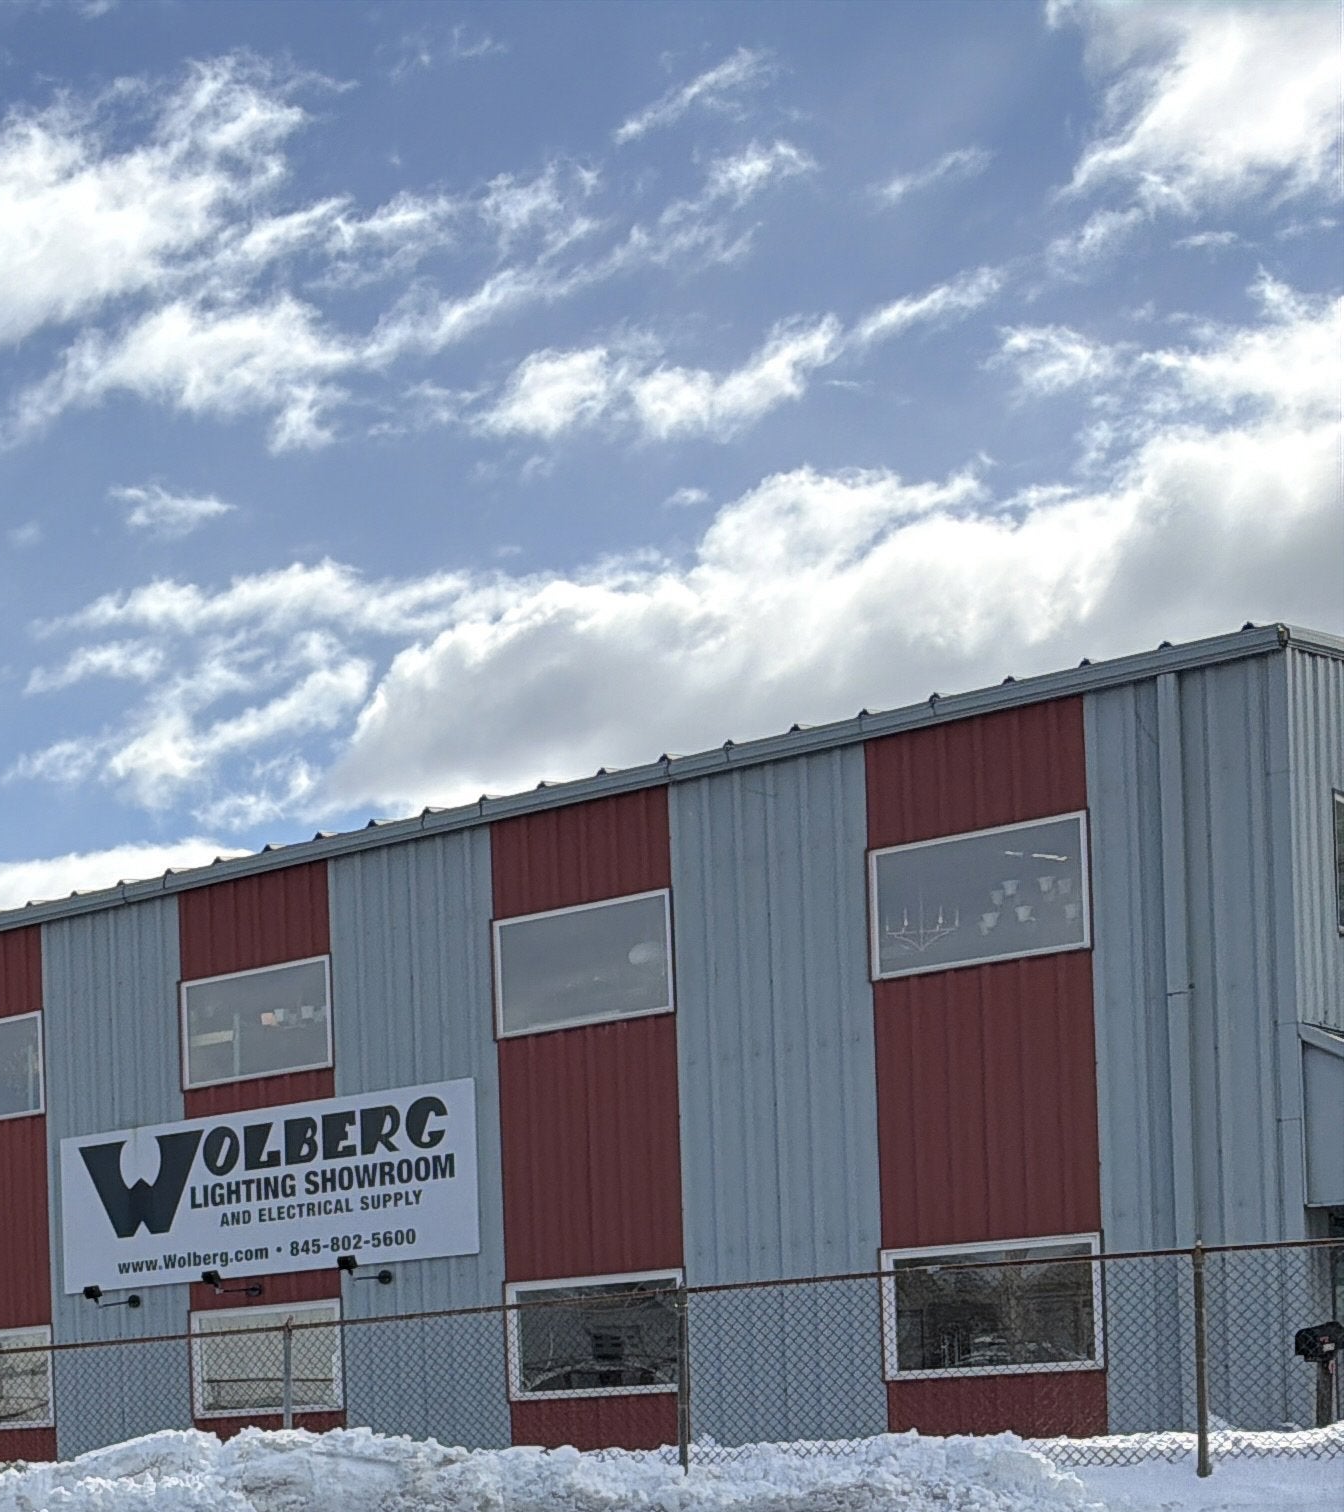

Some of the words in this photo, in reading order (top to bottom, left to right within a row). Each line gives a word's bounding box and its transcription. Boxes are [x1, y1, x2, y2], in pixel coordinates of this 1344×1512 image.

[79, 1097, 448, 1238] WOLBERG
[191, 1174, 296, 1209] LIGHTING
[305, 1153, 455, 1195] SHOWROOM
[220, 1210, 251, 1227] AND
[259, 1199, 353, 1222] ELECTRICAL
[360, 1190, 422, 1210] SUPPLY
[118, 1248, 268, 1274] www.Wolberg.com
[290, 1229, 416, 1256] 845-802-5600
